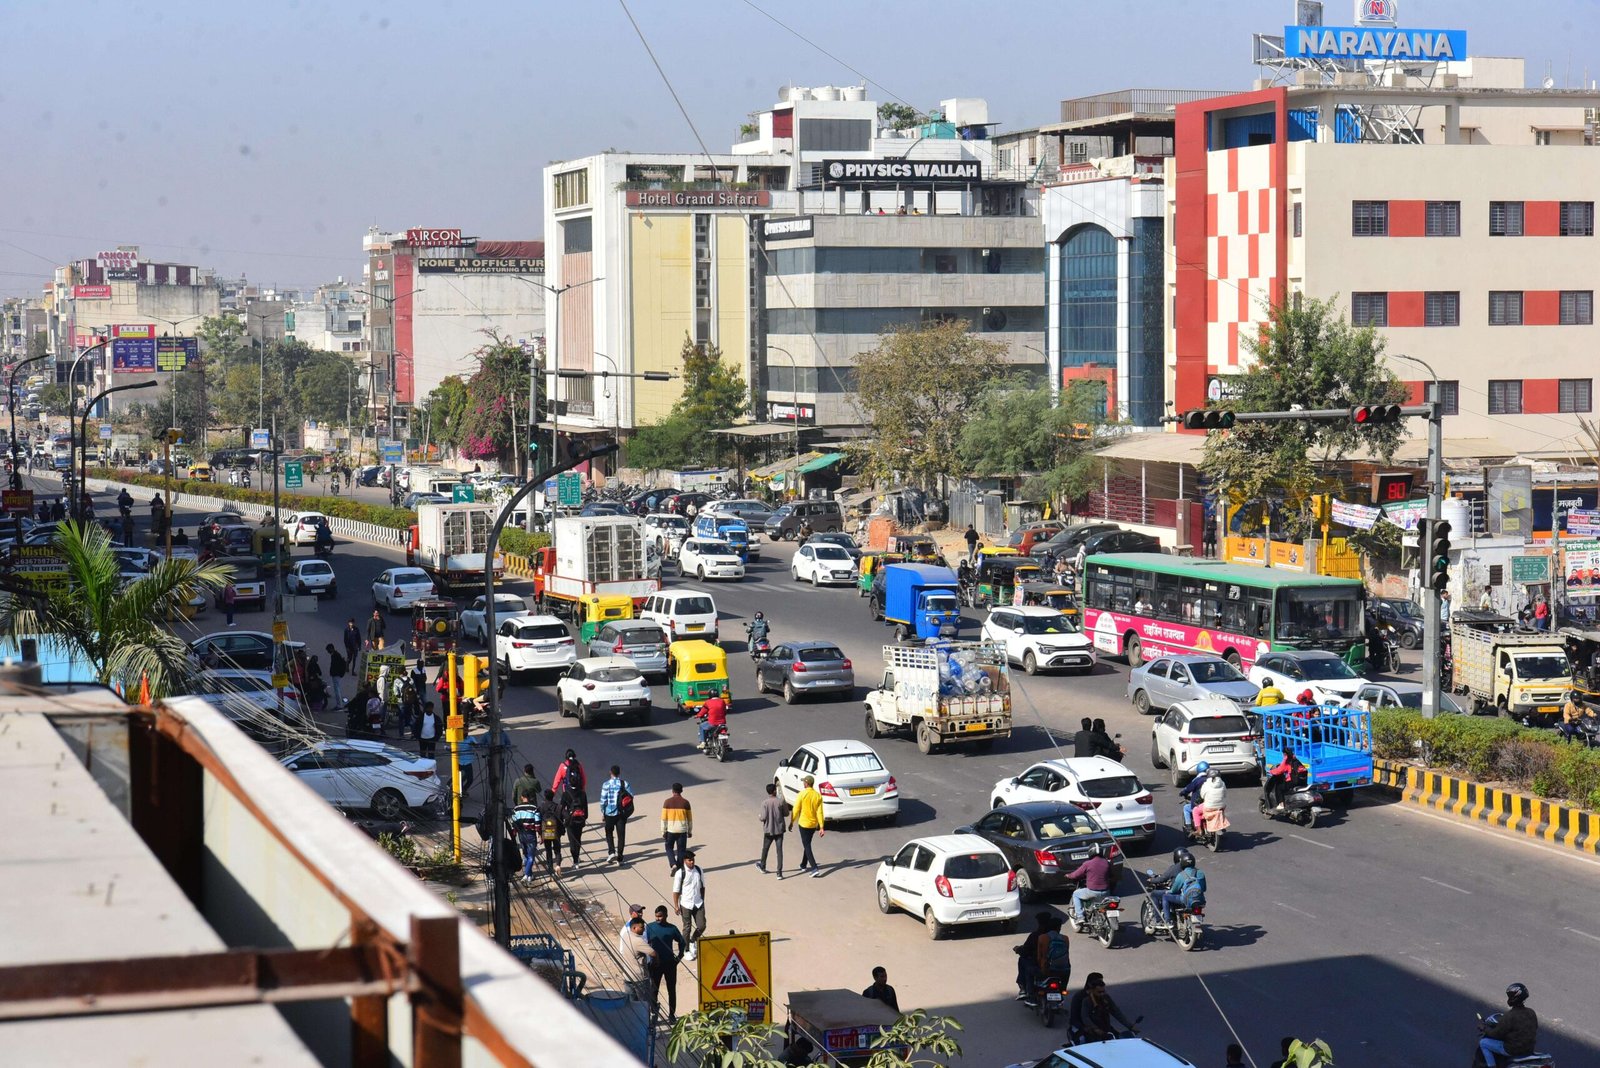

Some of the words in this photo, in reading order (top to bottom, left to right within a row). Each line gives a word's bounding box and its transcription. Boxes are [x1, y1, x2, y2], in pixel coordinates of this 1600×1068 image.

[1299, 30, 1453, 58] NARAYANA
[845, 164, 912, 177] PHYSICS
[913, 164, 978, 177] WALLAH
[638, 193, 671, 204] Hotel
[675, 193, 714, 204] Grand
[719, 192, 759, 205] Safari
[409, 230, 461, 241] AIRCON
[98, 251, 137, 260] ASHOKA
[103, 260, 132, 268] LITES
[419, 259, 456, 267] HOME
[459, 259, 468, 267] N
[472, 259, 516, 267] OFFICE
[1388, 482, 1406, 499] 80
[20, 546, 54, 557] Misthi
[1590, 557, 1600, 565] 16
[1143, 622, 1163, 638] राइजिंग
[1162, 627, 1185, 642] राजस्थान
